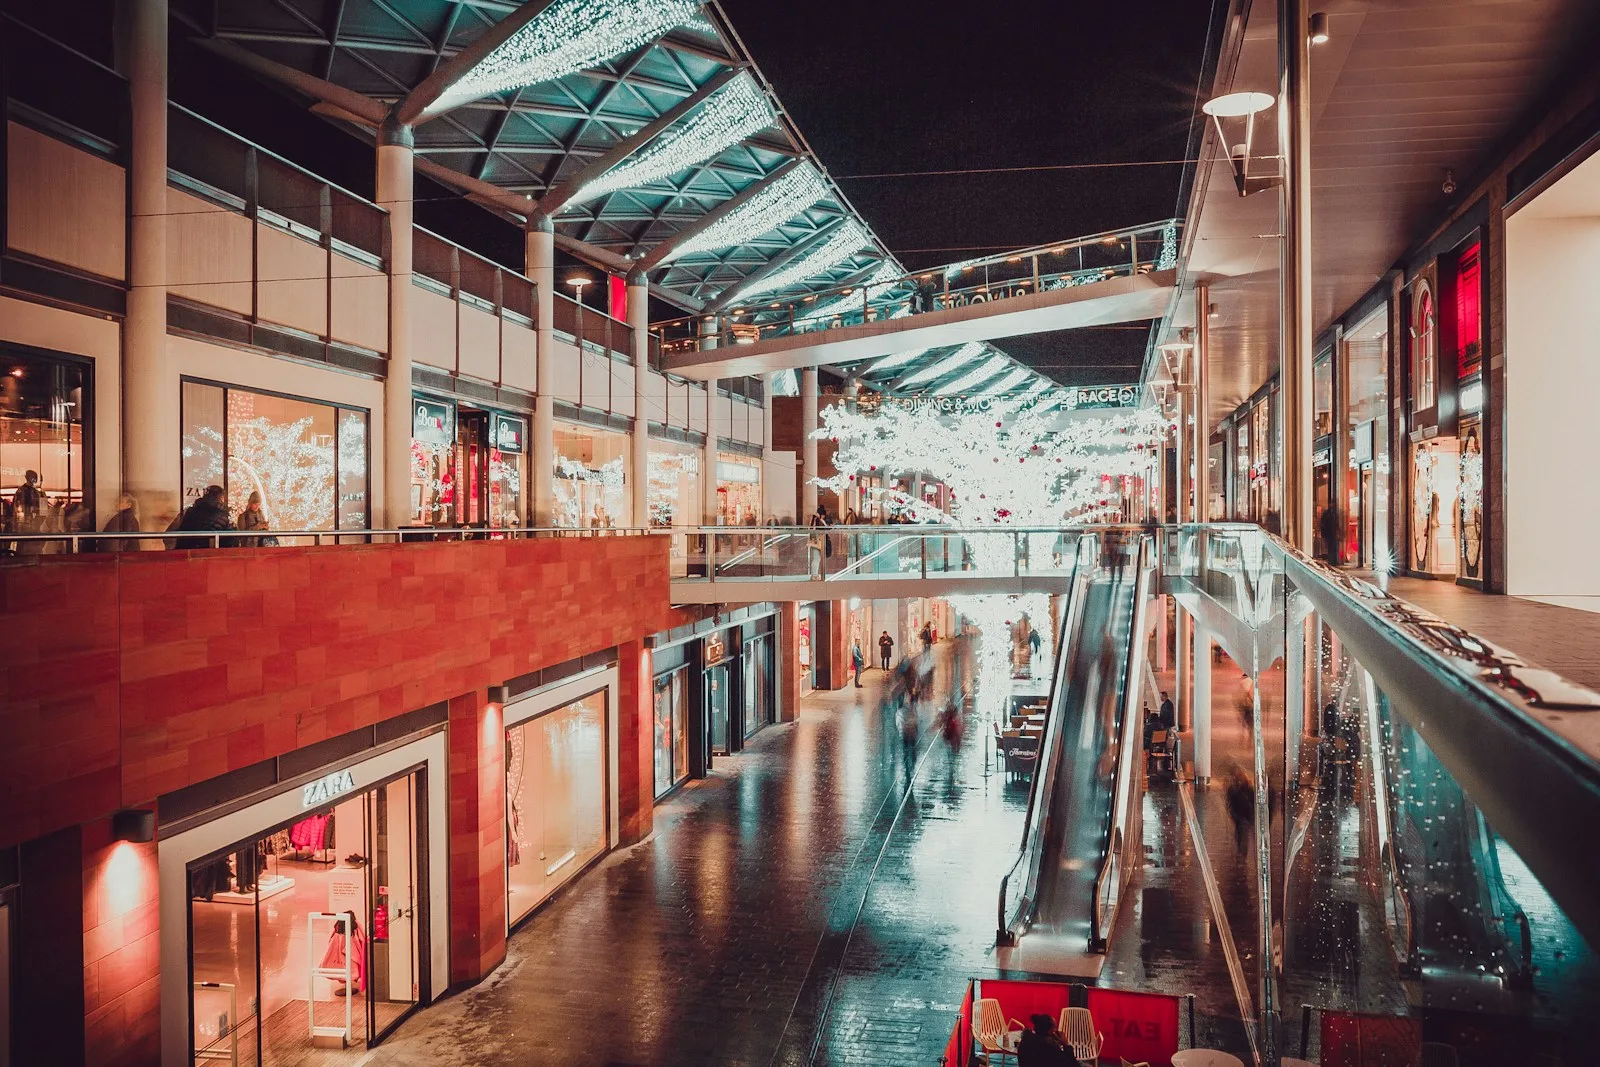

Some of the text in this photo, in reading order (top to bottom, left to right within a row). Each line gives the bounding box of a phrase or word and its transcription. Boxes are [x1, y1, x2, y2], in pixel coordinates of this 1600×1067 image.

[955, 398, 965, 410] &
[186, 487, 209, 498] ZAR
[304, 770, 355, 805] ZARA
